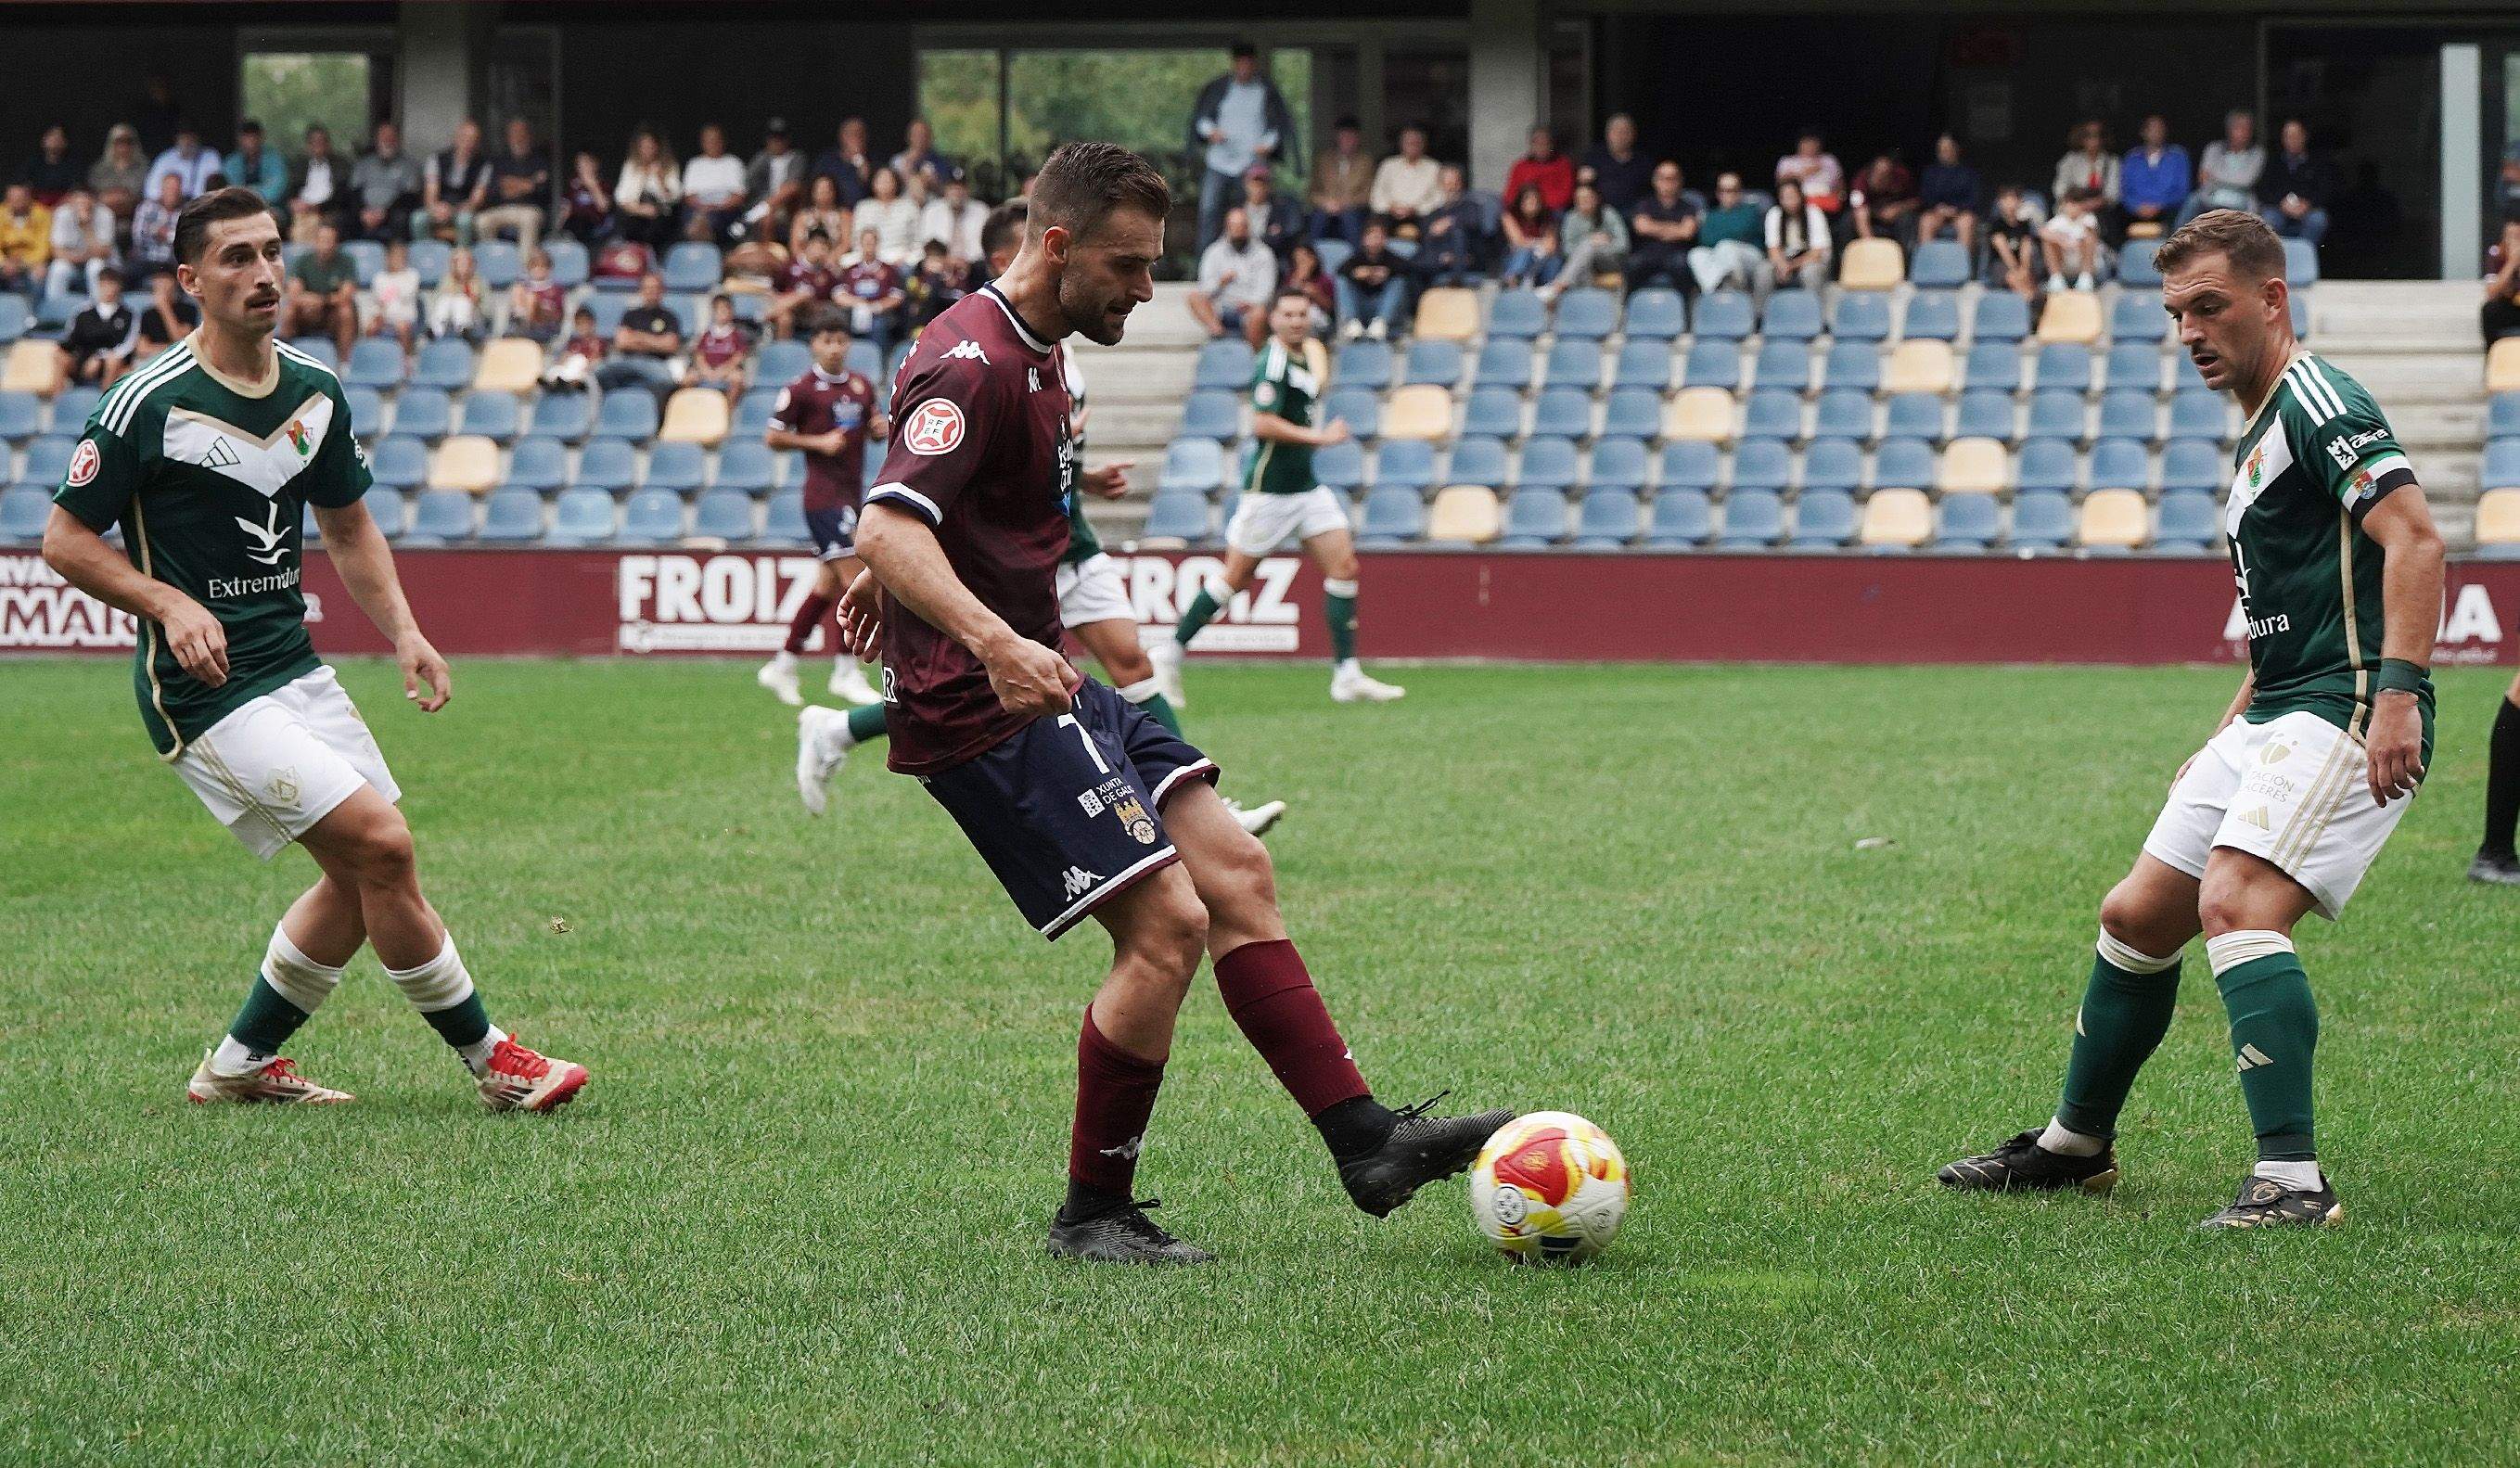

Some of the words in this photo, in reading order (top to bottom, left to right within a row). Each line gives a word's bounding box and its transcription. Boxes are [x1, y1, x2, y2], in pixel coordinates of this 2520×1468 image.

[619, 555, 822, 623] FROIZ
[1056, 712, 1110, 774] 7
[1095, 776, 1124, 796] XUNTA
[1102, 791, 1118, 805] DE
